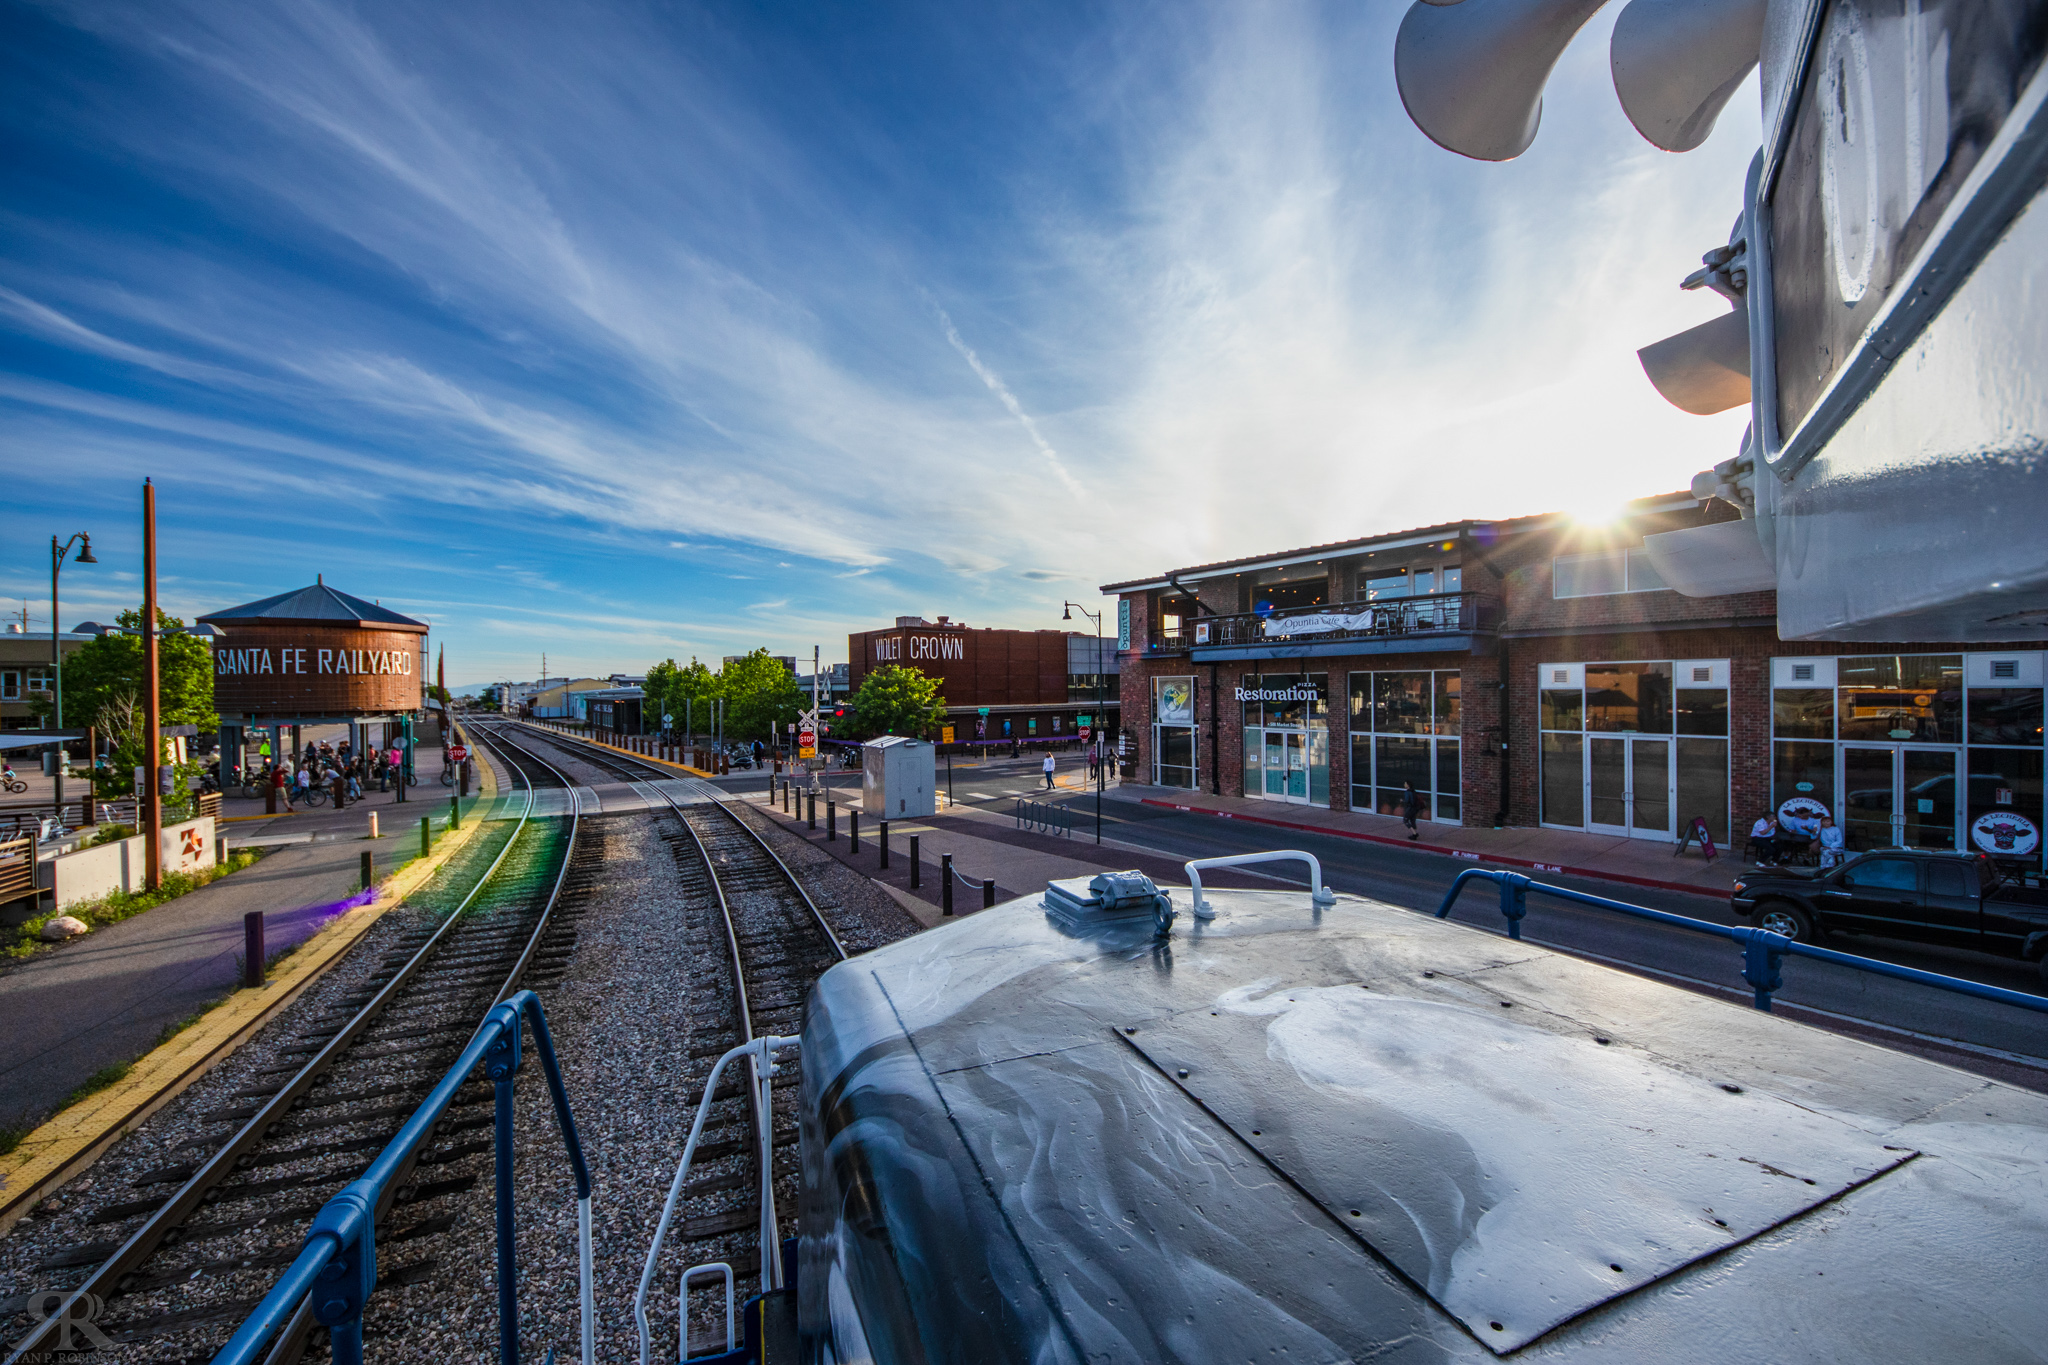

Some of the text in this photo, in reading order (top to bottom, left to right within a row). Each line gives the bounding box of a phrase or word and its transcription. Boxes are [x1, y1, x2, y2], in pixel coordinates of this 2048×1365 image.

[1285, 616, 1319, 629] Opuntia
[875, 635, 963, 661] VIOLET CROWN
[218, 648, 412, 676] SANTA FE RAILYARD
[1234, 685, 1319, 702] Restoration
[800, 735, 815, 743] STOP
[449, 749, 466, 758] STOP
[1792, 799, 1824, 811] LECHERIA
[1978, 813, 2030, 828] LA LECHERIA
[1461, 851, 1479, 860] PARKING
[1547, 865, 1562, 873] LANE
